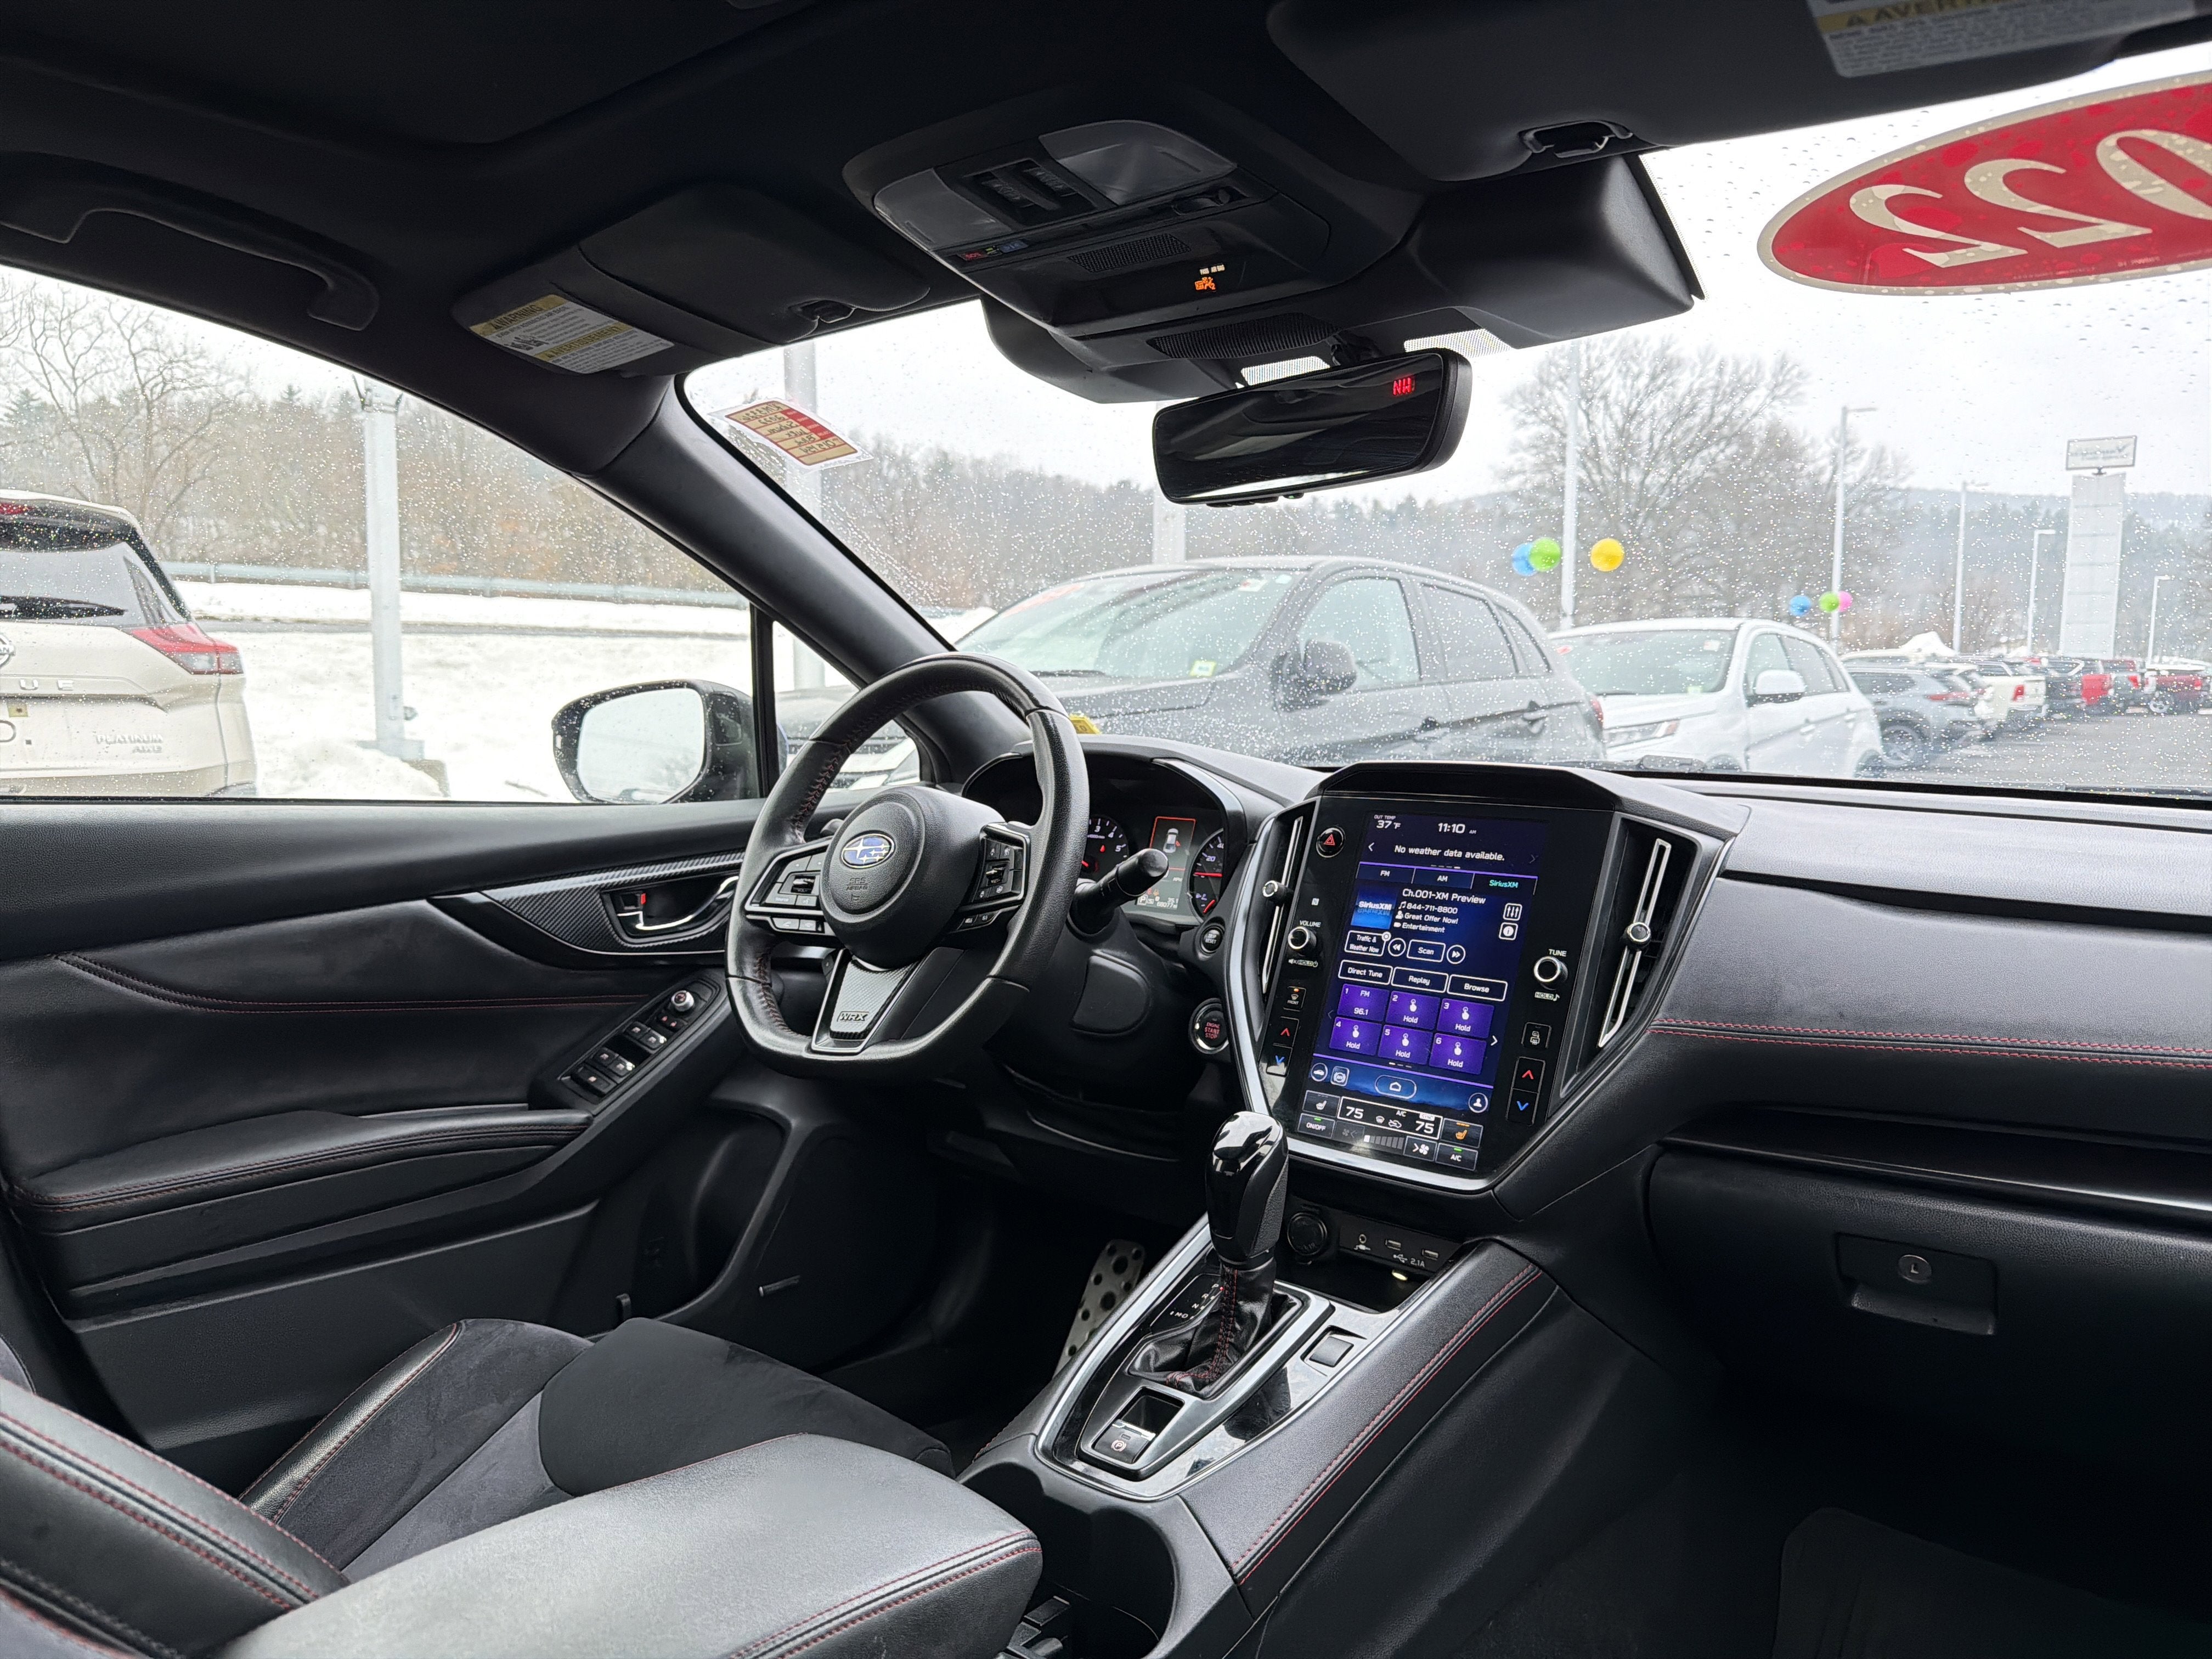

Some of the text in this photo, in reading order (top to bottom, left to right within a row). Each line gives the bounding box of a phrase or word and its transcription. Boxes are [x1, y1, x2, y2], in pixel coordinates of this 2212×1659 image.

[500, 305, 542, 330] WARNING
[552, 326, 621, 357] AVERTISSEMENT
[96, 733, 163, 744] PLATINUM
[1376, 820, 1392, 830] 37
[1438, 822, 1466, 834] 11:10
[1394, 845, 1505, 861] No weather data available.
[1489, 879, 1519, 889] SiriusXM
[1402, 888, 1486, 905] Ch.001-XM Preview
[1358, 901, 1392, 911] SiriusXM
[1406, 903, 1458, 914] 844-711-8800
[1404, 913, 1423, 921] Great
[1424, 915, 1441, 923] Offer
[1402, 922, 1445, 933] Entertainment
[1350, 944, 1368, 952] Weather
[1418, 947, 1435, 955] Scan
[1548, 949, 1567, 957] TUNE
[1347, 967, 1383, 978] Direct Tune
[1408, 975, 1430, 985] Replay
[1464, 984, 1489, 993] Browse
[1353, 1007, 1368, 1016] 96.1
[840, 1013, 868, 1022] WRX
[1403, 1015, 1418, 1024] Hold
[1455, 1023, 1471, 1032] Hold
[1346, 1041, 1361, 1049] Hold
[1395, 1049, 1411, 1058] Hold
[1447, 1059, 1464, 1068] Hold
[1345, 1106, 1364, 1119] 75
[1306, 1122, 1326, 1131] ON/OFF
[1415, 1120, 1435, 1135] 75
[1451, 1154, 1462, 1162] A/C
[1410, 1257, 1425, 1268] 2.1A
